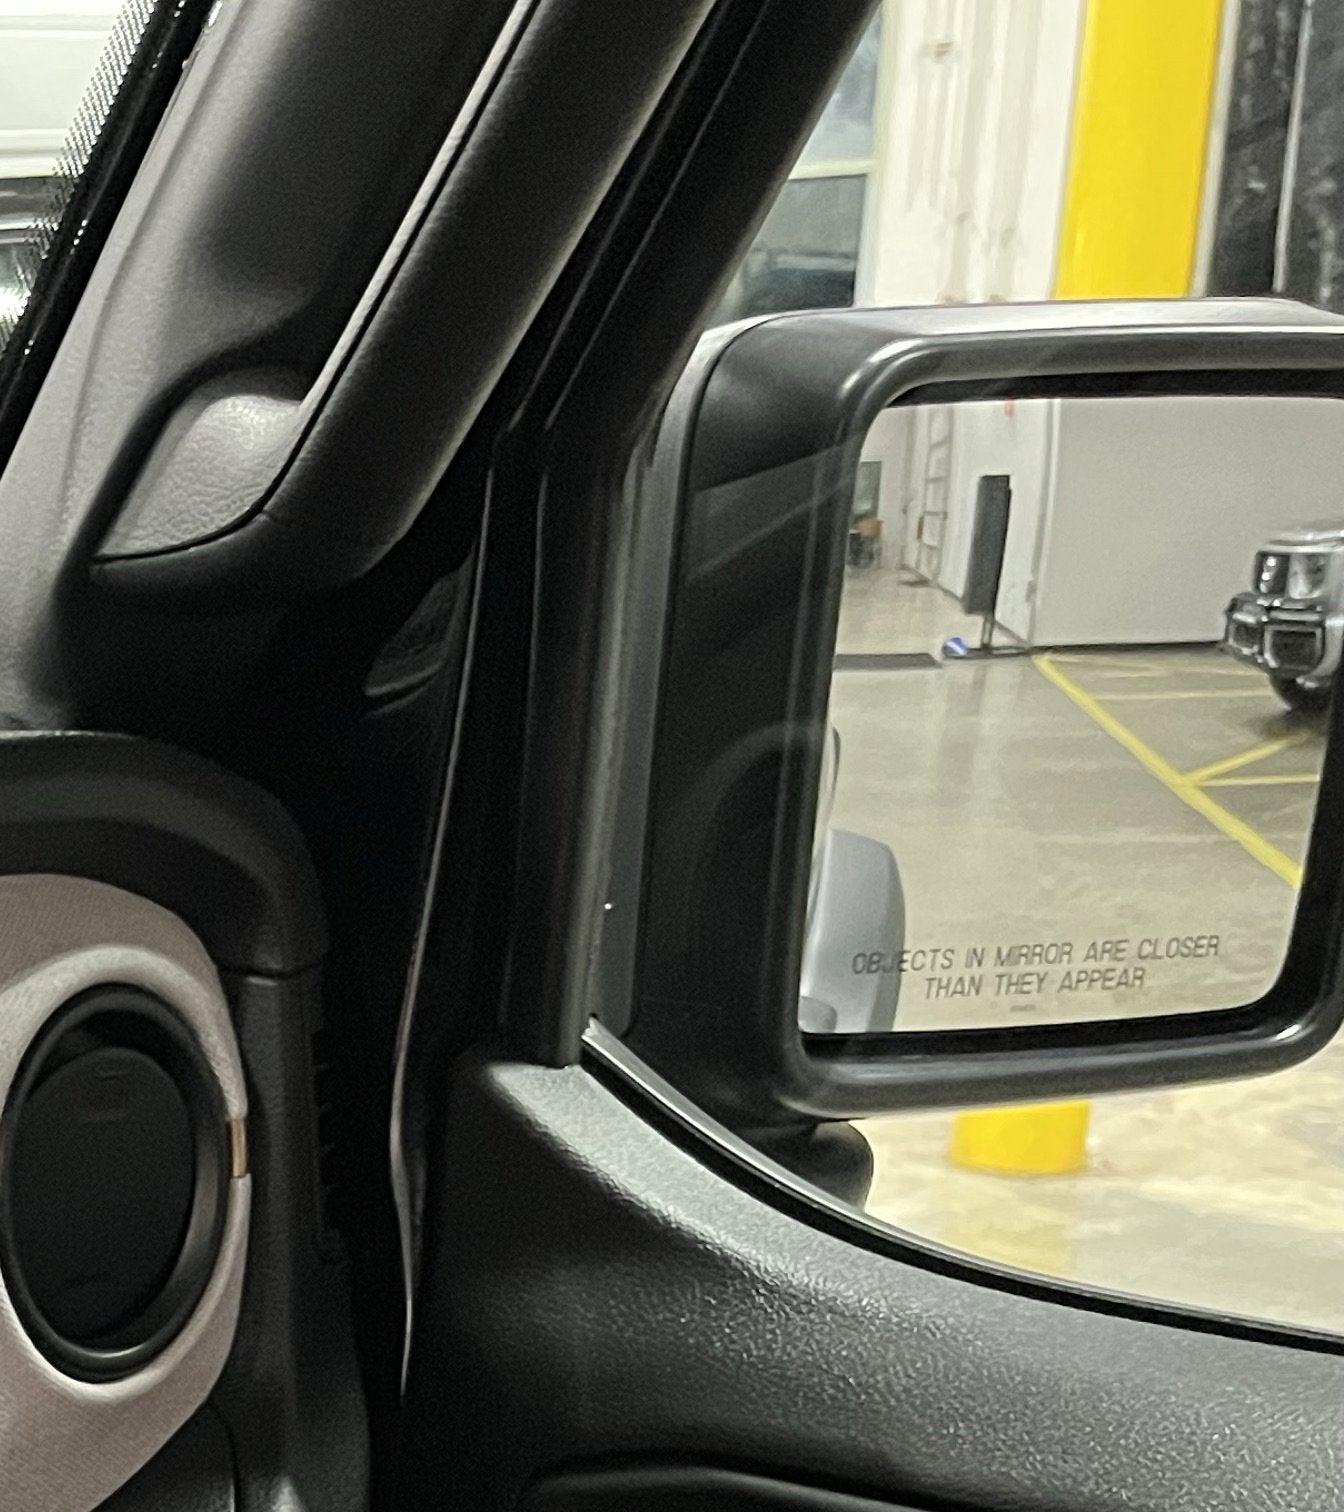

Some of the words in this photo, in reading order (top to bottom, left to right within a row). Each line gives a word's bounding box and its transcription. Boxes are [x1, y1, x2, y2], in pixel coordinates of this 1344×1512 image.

[851, 949, 955, 975] OBJECTS
[965, 947, 986, 969] IN
[994, 942, 1074, 968] MIRROR
[1083, 939, 1129, 964] ARE
[1137, 935, 1221, 961] CLOSER
[925, 974, 983, 1001] THAN
[995, 972, 1049, 997] THEY
[1058, 967, 1146, 994] APPEAR
